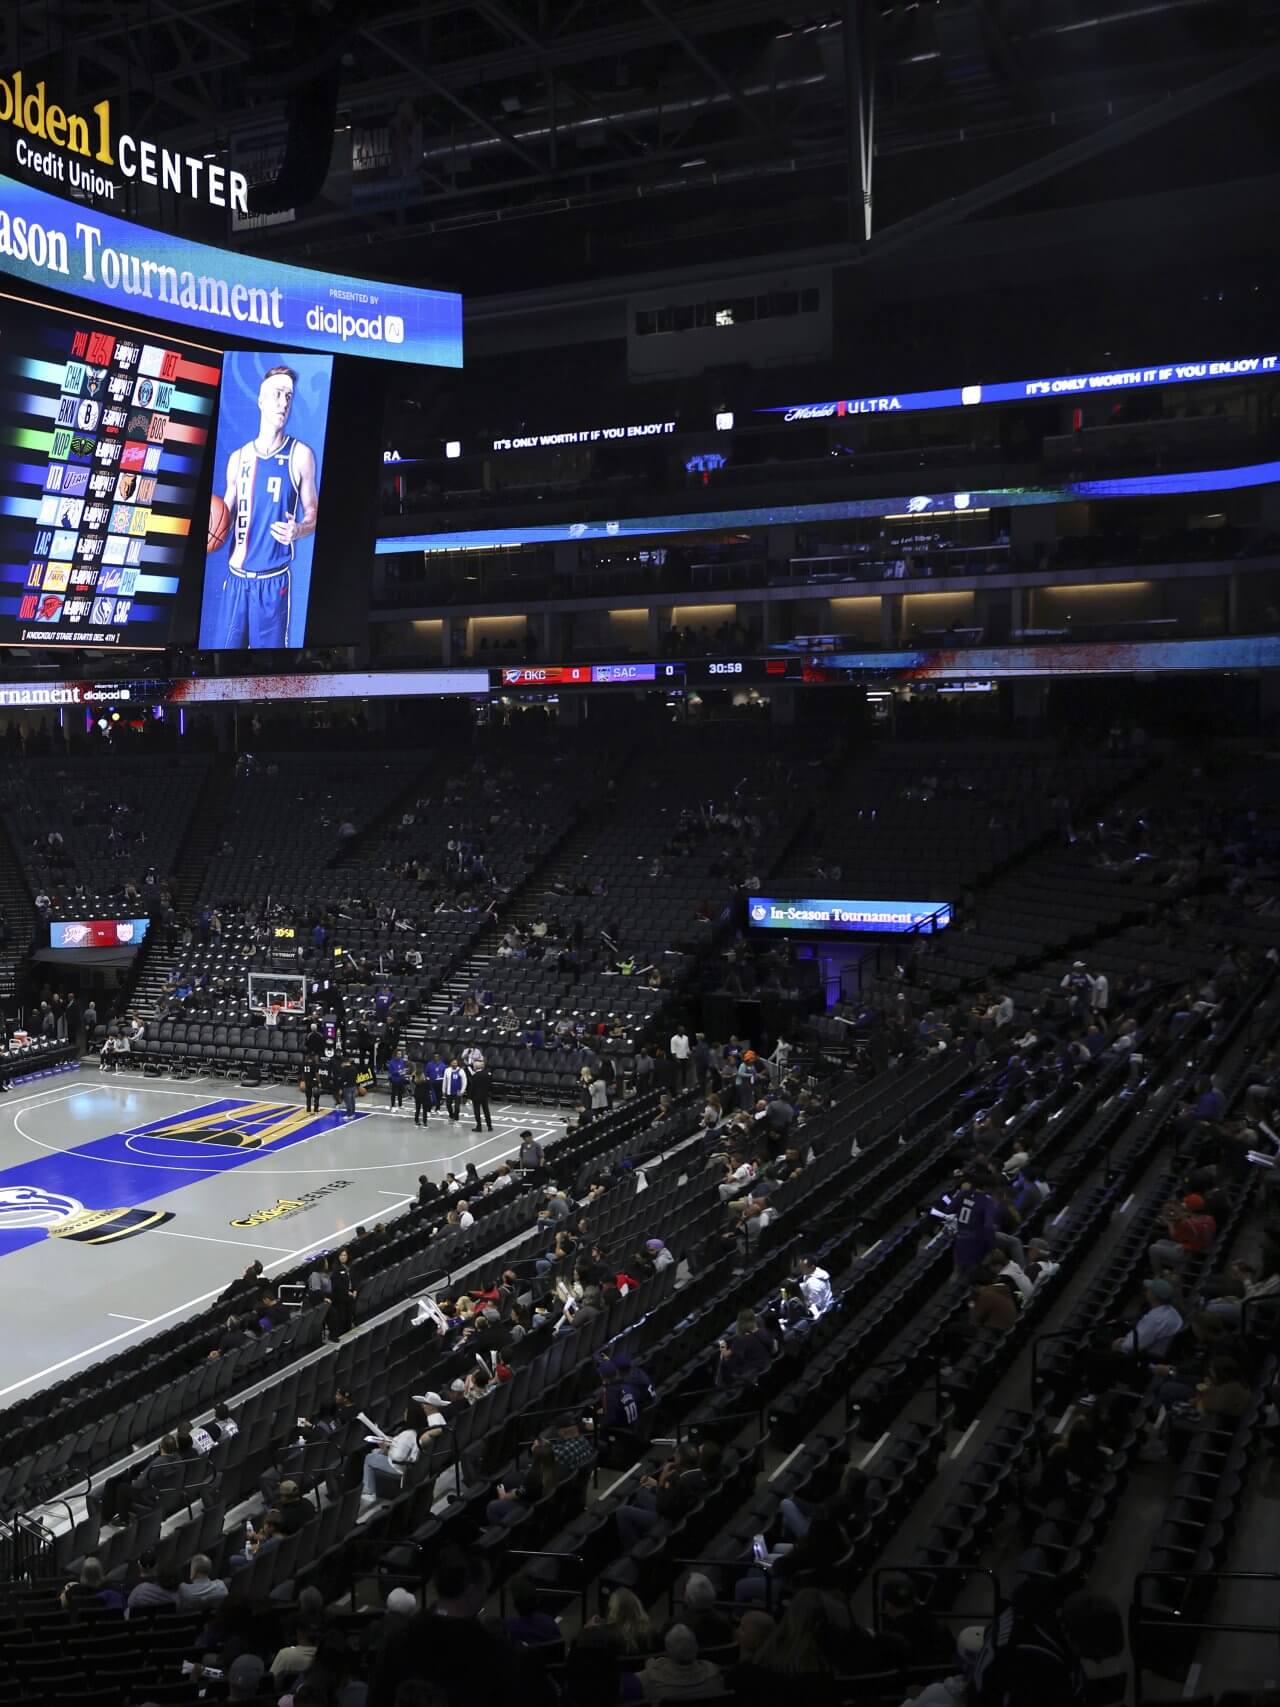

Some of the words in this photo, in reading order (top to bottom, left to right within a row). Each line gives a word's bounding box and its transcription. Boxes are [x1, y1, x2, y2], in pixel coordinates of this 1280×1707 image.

[16, 139, 64, 183] Credit
[69, 162, 115, 200] Union
[119, 135, 249, 213] CENTER
[76, 222, 283, 329] Tournament
[329, 288, 368, 304] PRESENTED
[369, 295, 379, 305] BY
[306, 303, 383, 341] dialpad
[65, 365, 81, 390] CHA
[1025, 381, 1050, 395] IT'S
[1051, 378, 1088, 392] ONLY
[1089, 373, 1141, 388] WORTH
[1143, 370, 1157, 382] IT
[1159, 368, 1173, 380] IF
[1175, 365, 1207, 378] YOU
[1209, 359, 1259, 375] ENJOY
[1262, 356, 1278, 369] IT
[156, 384, 173, 409] WAS
[848, 398, 902, 414] ULTRA
[58, 398, 77, 423] BKN
[150, 416, 166, 441] BOS
[493, 439, 511, 450] IT'S
[513, 436, 539, 448] ONLY
[540, 433, 578, 446] WORTH
[579, 431, 589, 442] IT
[591, 430, 601, 440] IF
[603, 428, 625, 439] YOU
[627, 424, 663, 437] ENJOY
[665, 422, 676, 433] IT
[51, 431, 70, 456] NOP
[266, 476, 282, 503] 9
[131, 510, 149, 533] SAS
[34, 531, 51, 555] LAC
[27, 563, 44, 586] LAL
[114, 598, 131, 623] SAC
[26, 630, 56, 640] KNOCKOUT
[56, 631, 73, 640] STAGE
[73, 632, 93, 641] STARTS
[524, 670, 546, 681] OKC
[613, 667, 636, 678] SAC
[709, 662, 742, 674] 30:58
[83, 689, 120, 701] dialpad
[770, 906, 830, 921] In-Season
[832, 908, 912, 924] Tournament
[297, 1179, 355, 1202] CENTER
